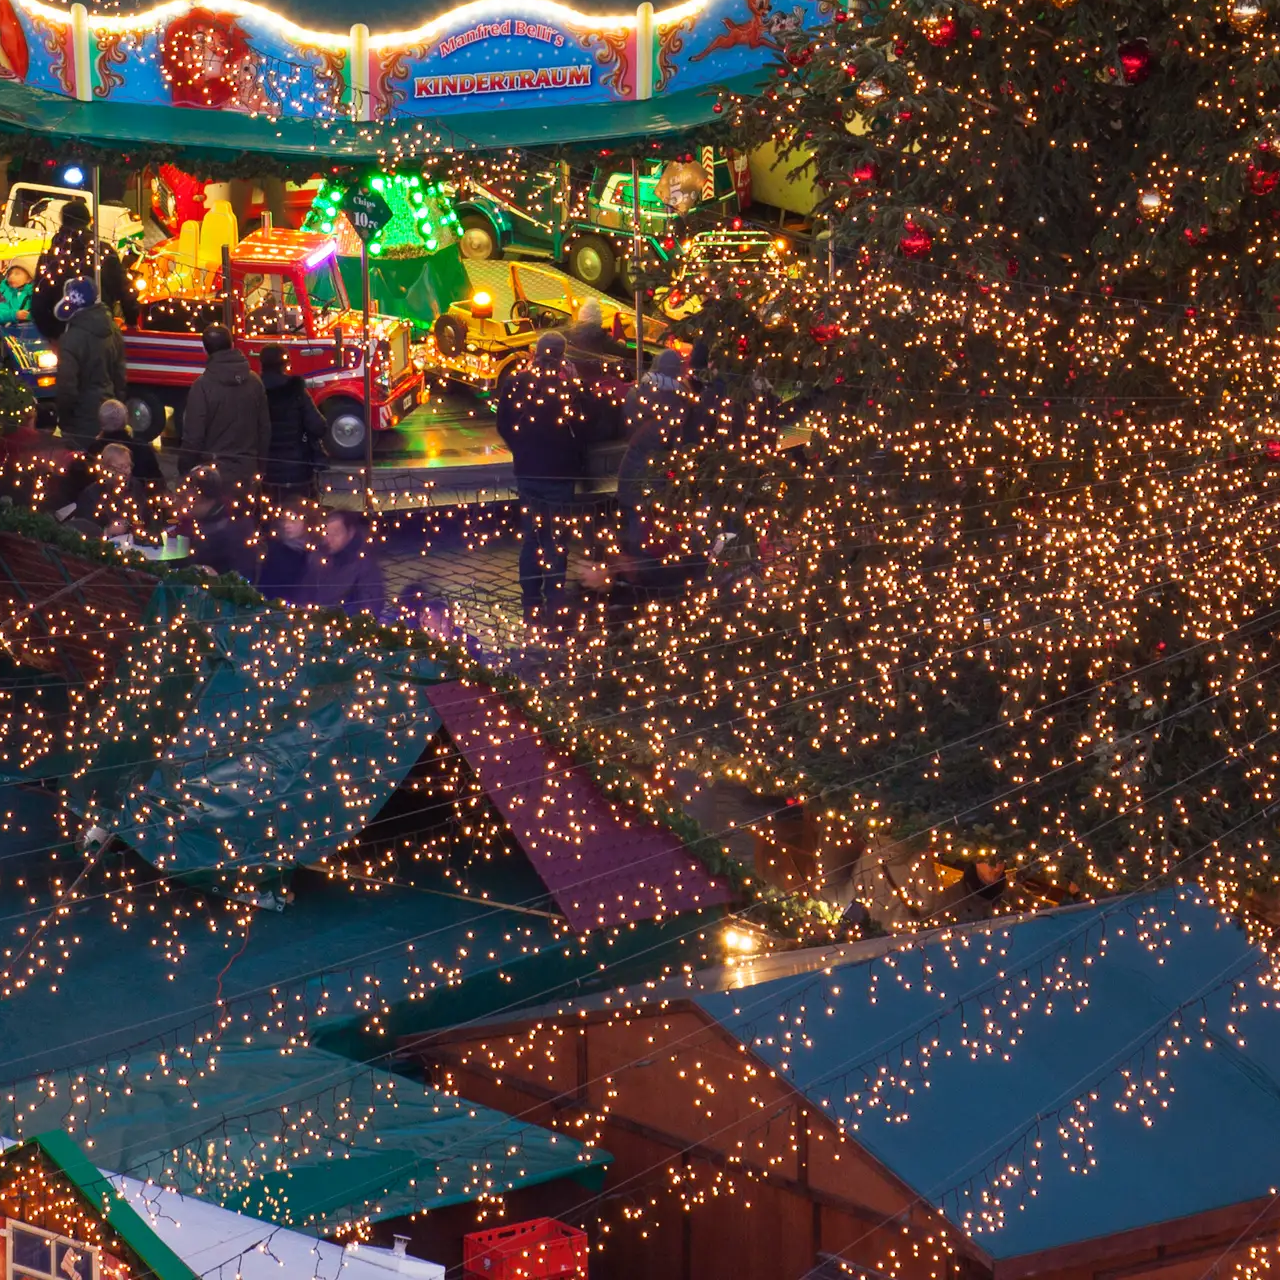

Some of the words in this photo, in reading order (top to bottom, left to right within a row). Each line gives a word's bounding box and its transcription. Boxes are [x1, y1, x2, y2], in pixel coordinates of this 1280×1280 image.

[440, 19, 511, 58] Manfred
[414, 64, 592, 99] KINDERTRAUM
[352, 196, 376, 208] Chips
